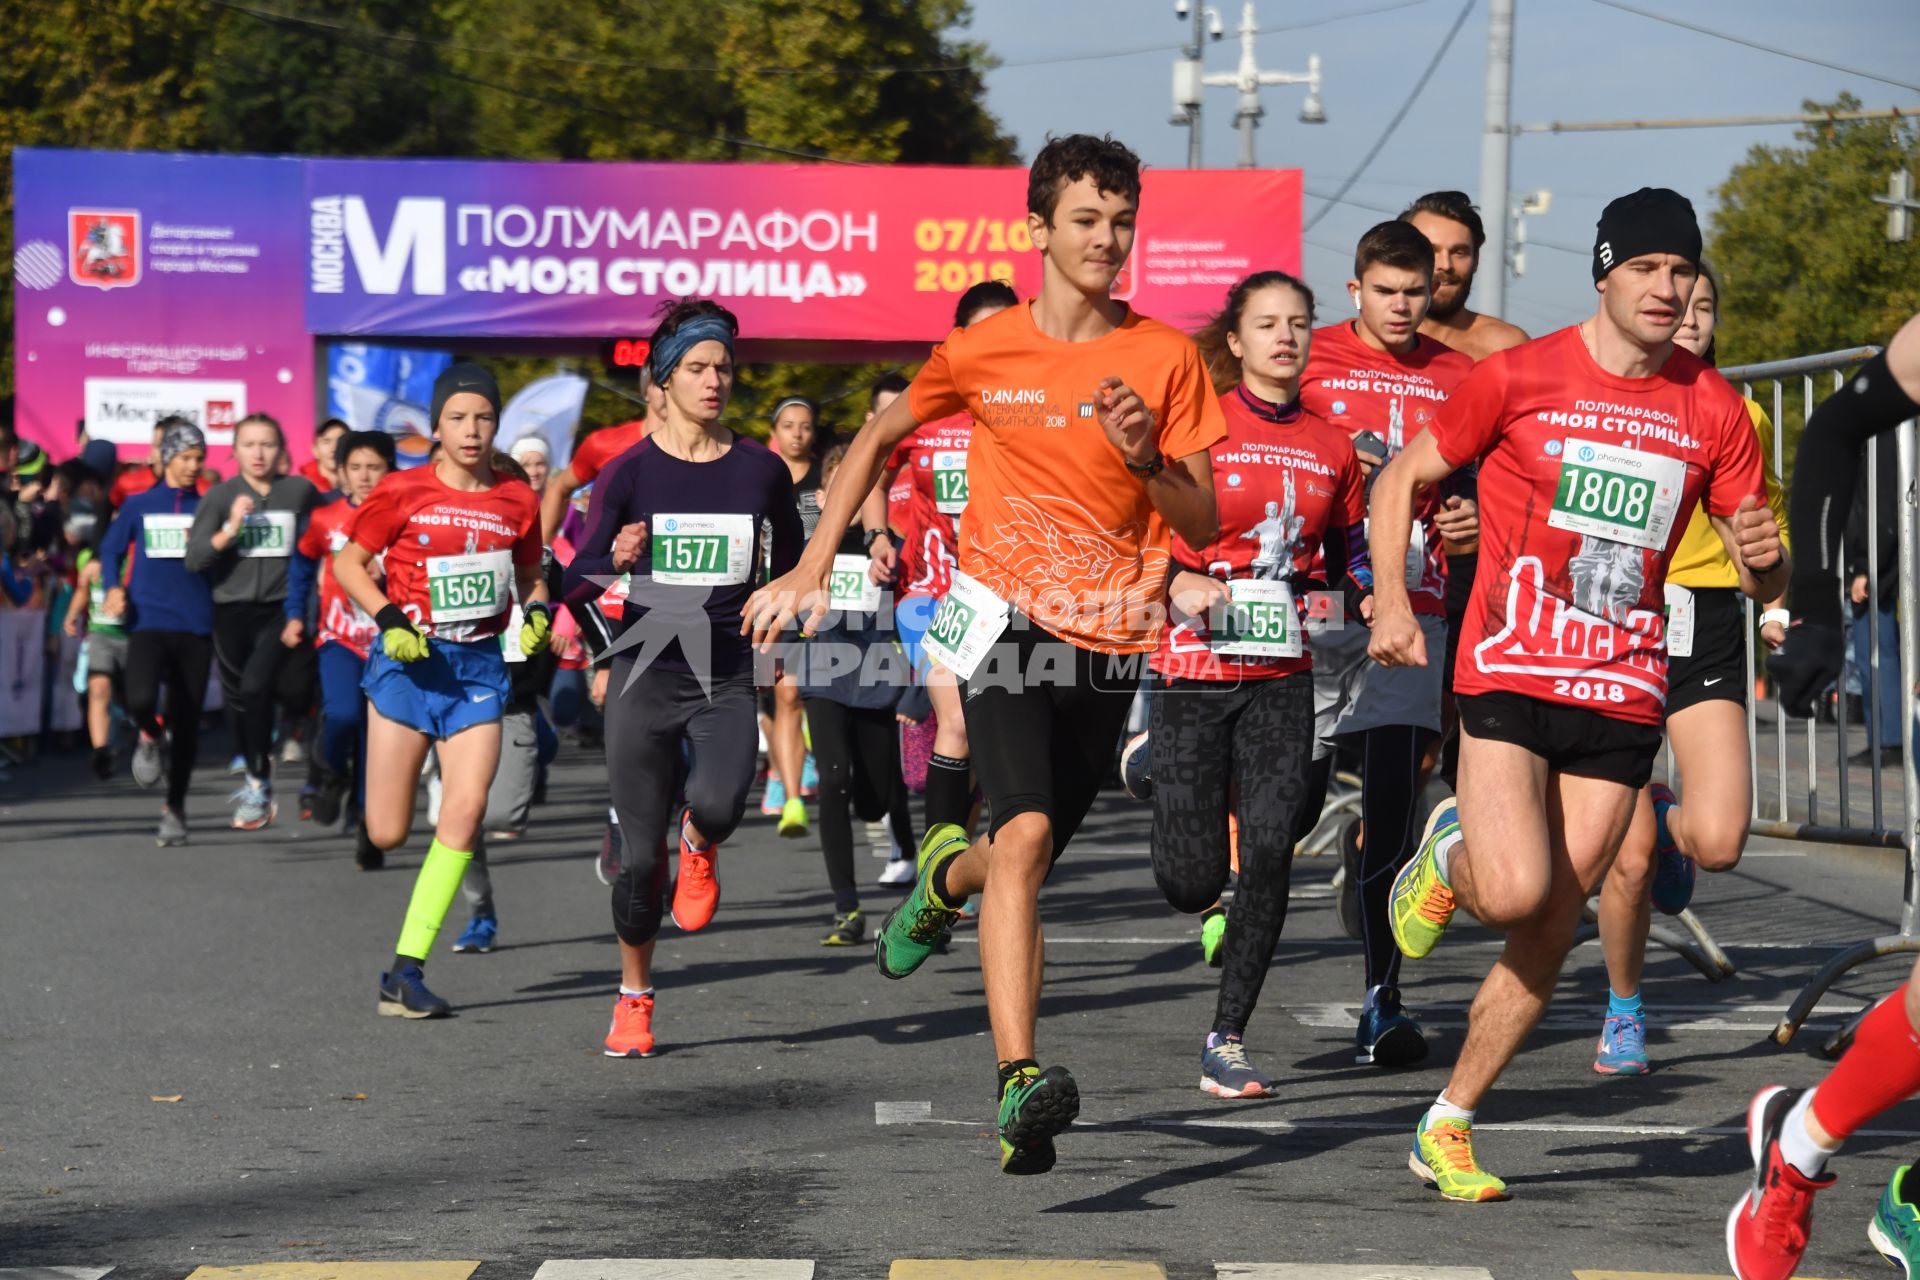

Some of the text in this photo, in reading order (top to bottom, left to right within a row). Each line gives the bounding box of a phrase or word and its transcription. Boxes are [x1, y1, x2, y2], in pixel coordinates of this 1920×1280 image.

[457, 205, 878, 253] ПОЛУМАРАФОН
[914, 217, 1033, 253] 07/10
[311, 196, 343, 293] МОСКВА
[458, 256, 868, 303] «МОЯ СТОЛИЦА»
[914, 262, 1014, 292] 2018
[1320, 378, 1370, 391] «МОЯ
[1349, 369, 1434, 386] ПОЛУМАРАФОН
[981, 389, 1046, 404] DANANG
[1045, 416, 1067, 429] 2018
[1575, 399, 1679, 426] ПОЛУМАРАФОН
[1536, 411, 1701, 450] «МОЯ СТОЛИЦА»
[1216, 452, 1261, 464] «МОЯ
[1241, 442, 1316, 461] ПОЛУМАРАФОН
[1564, 468, 1649, 523] 1808
[410, 514, 450, 526] «МОЯ
[434, 506, 503, 522] ПОЛУМАРАФОН
[661, 537, 720, 569] 1577
[433, 574, 492, 608] 1562
[1220, 603, 1283, 640] 1055
[1553, 679, 1626, 703] 2018
